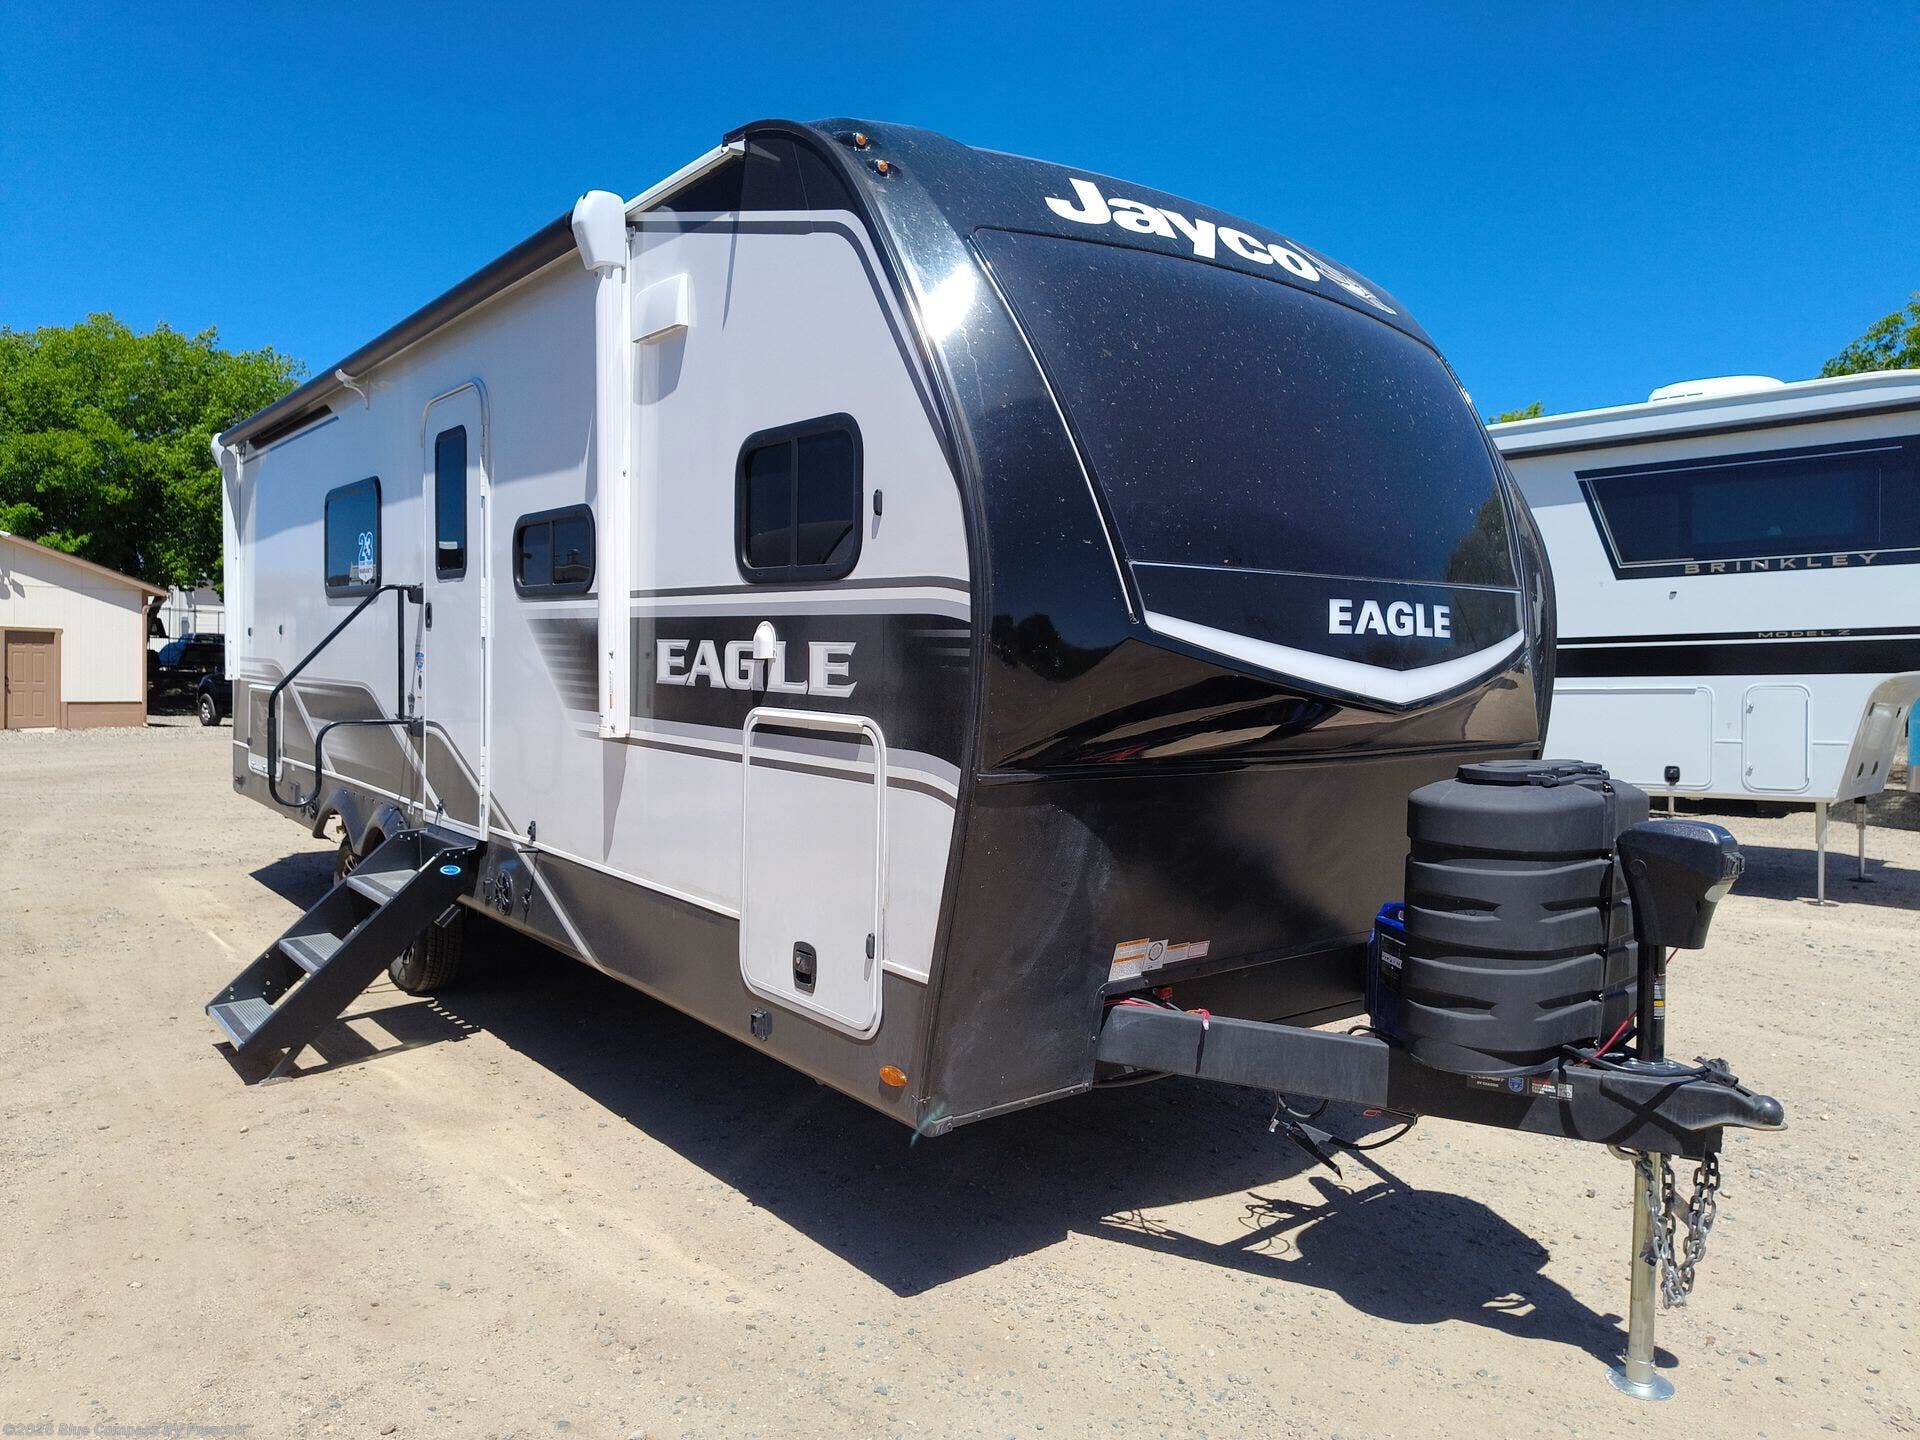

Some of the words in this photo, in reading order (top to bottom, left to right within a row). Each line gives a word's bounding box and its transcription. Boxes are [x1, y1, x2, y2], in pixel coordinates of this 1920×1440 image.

[1044, 177, 1320, 282] Jayco
[1684, 553, 1877, 575] BRINKLEY
[1328, 598, 1451, 639] EAGLE
[1757, 630, 1831, 639] MODEL
[655, 638, 857, 698] EAGLE
